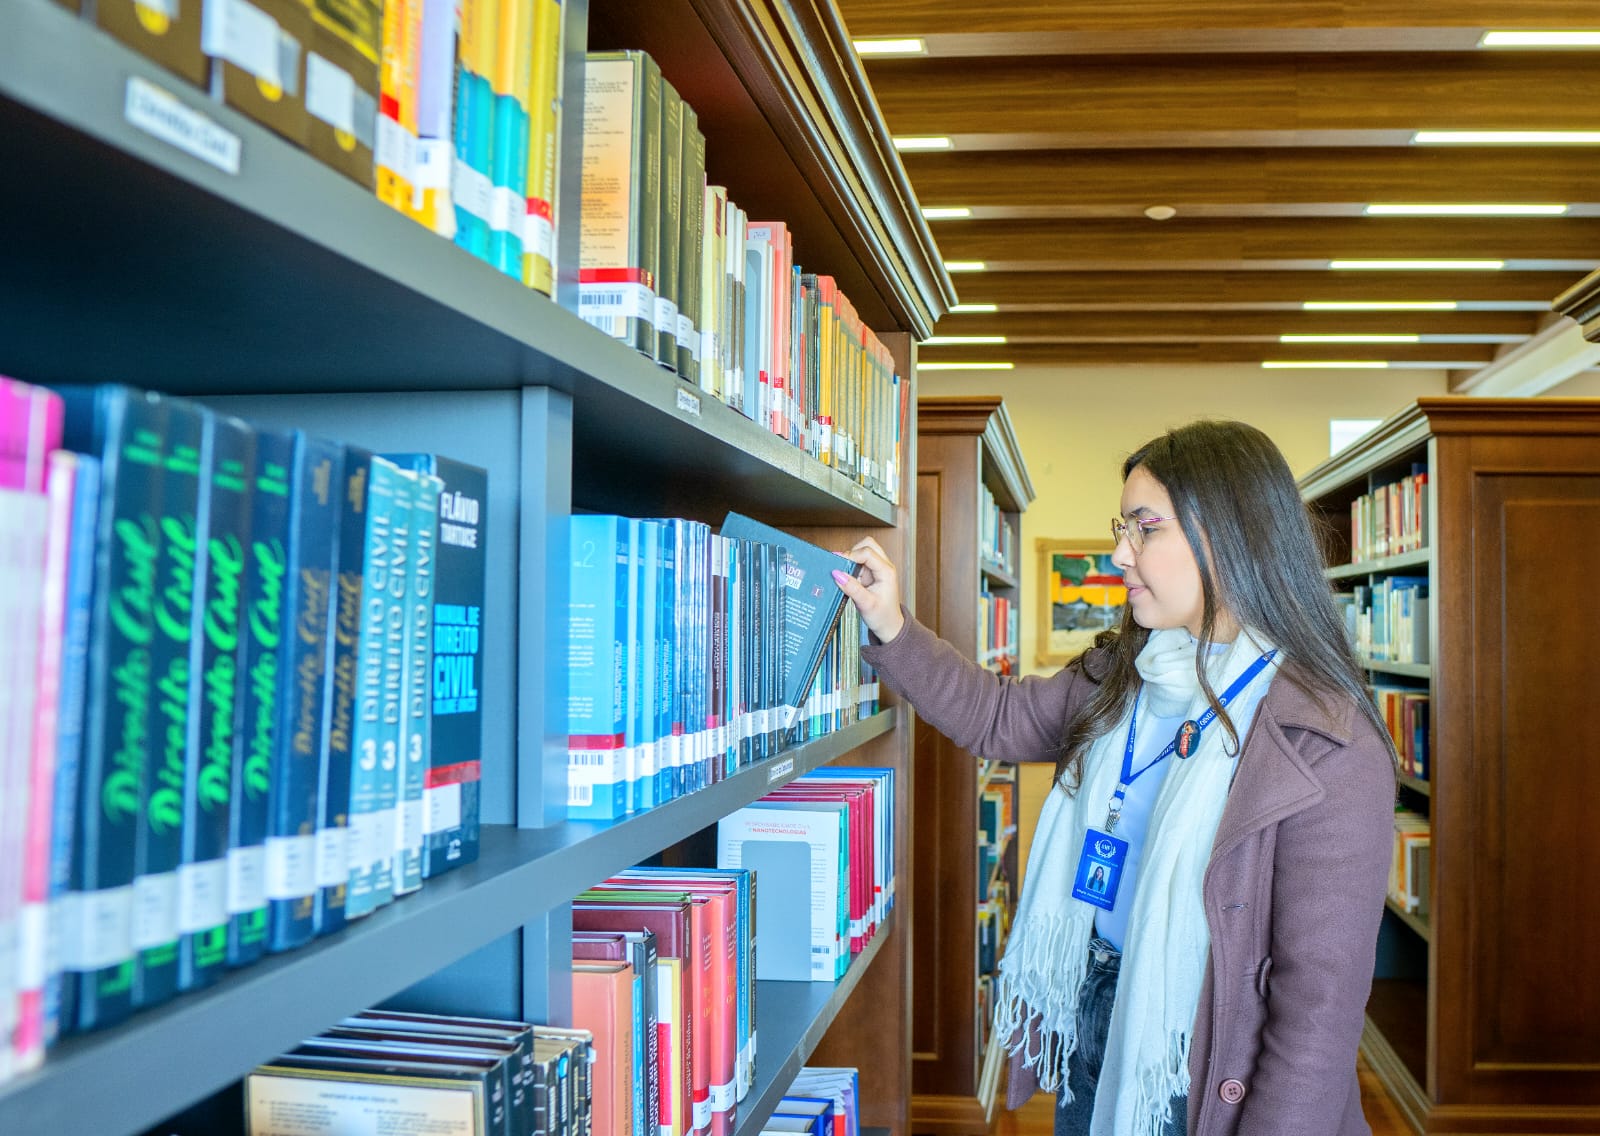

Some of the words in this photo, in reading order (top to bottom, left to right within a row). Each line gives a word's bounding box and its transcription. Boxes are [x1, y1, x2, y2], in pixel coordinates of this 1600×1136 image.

[440, 490, 479, 525] FLÁVIO
[370, 515, 390, 590] CIVIL
[388, 525, 409, 598] CIVIL
[413, 529, 431, 597] CIVIL
[582, 540, 595, 568] 2
[434, 625, 479, 654] DIREITO
[361, 598, 384, 722] DIREITO
[383, 605, 403, 724] DIREITO
[410, 604, 427, 718] DIREITO
[434, 655, 478, 698] CIVIL
[360, 738, 378, 771] 3
[381, 740, 396, 771] 3
[409, 733, 423, 763] 3
[752, 827, 807, 836] NANOTECNOLOGIAS
